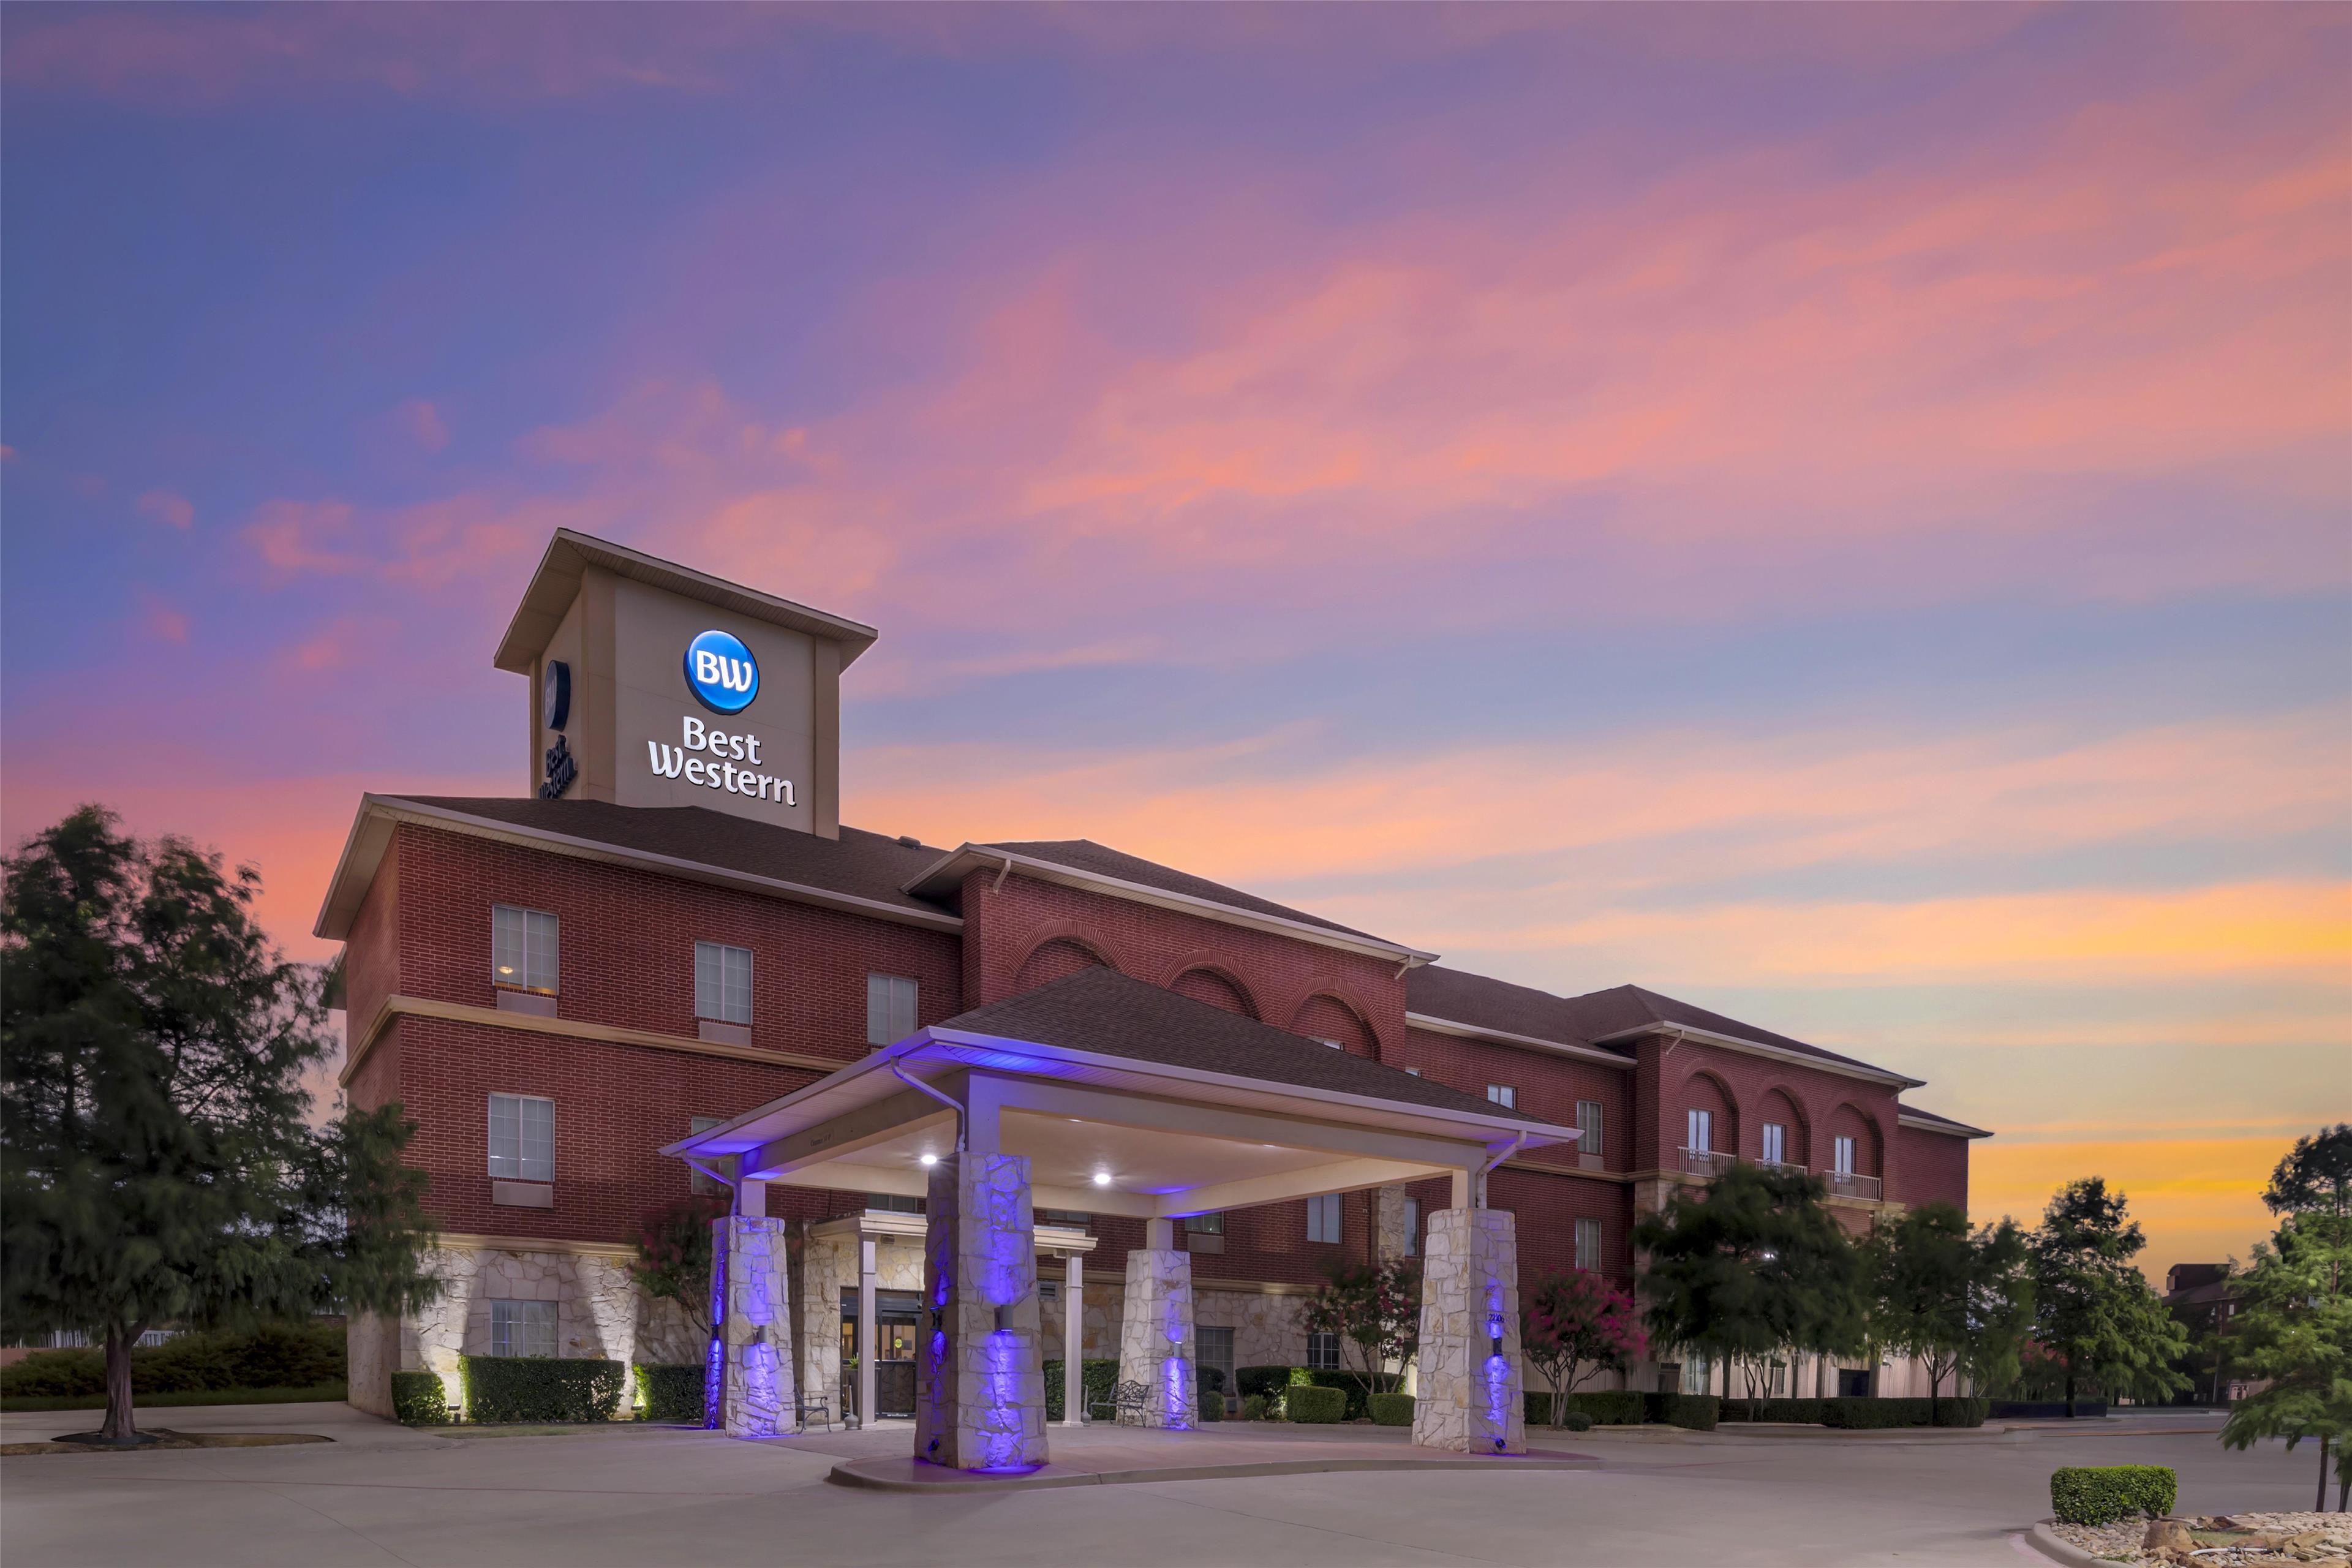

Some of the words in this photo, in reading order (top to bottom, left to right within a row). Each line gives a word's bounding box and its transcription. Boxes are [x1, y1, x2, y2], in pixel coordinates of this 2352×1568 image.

[696, 650, 752, 692] BW
[684, 716, 761, 765] Best
[648, 741, 796, 806] Western
